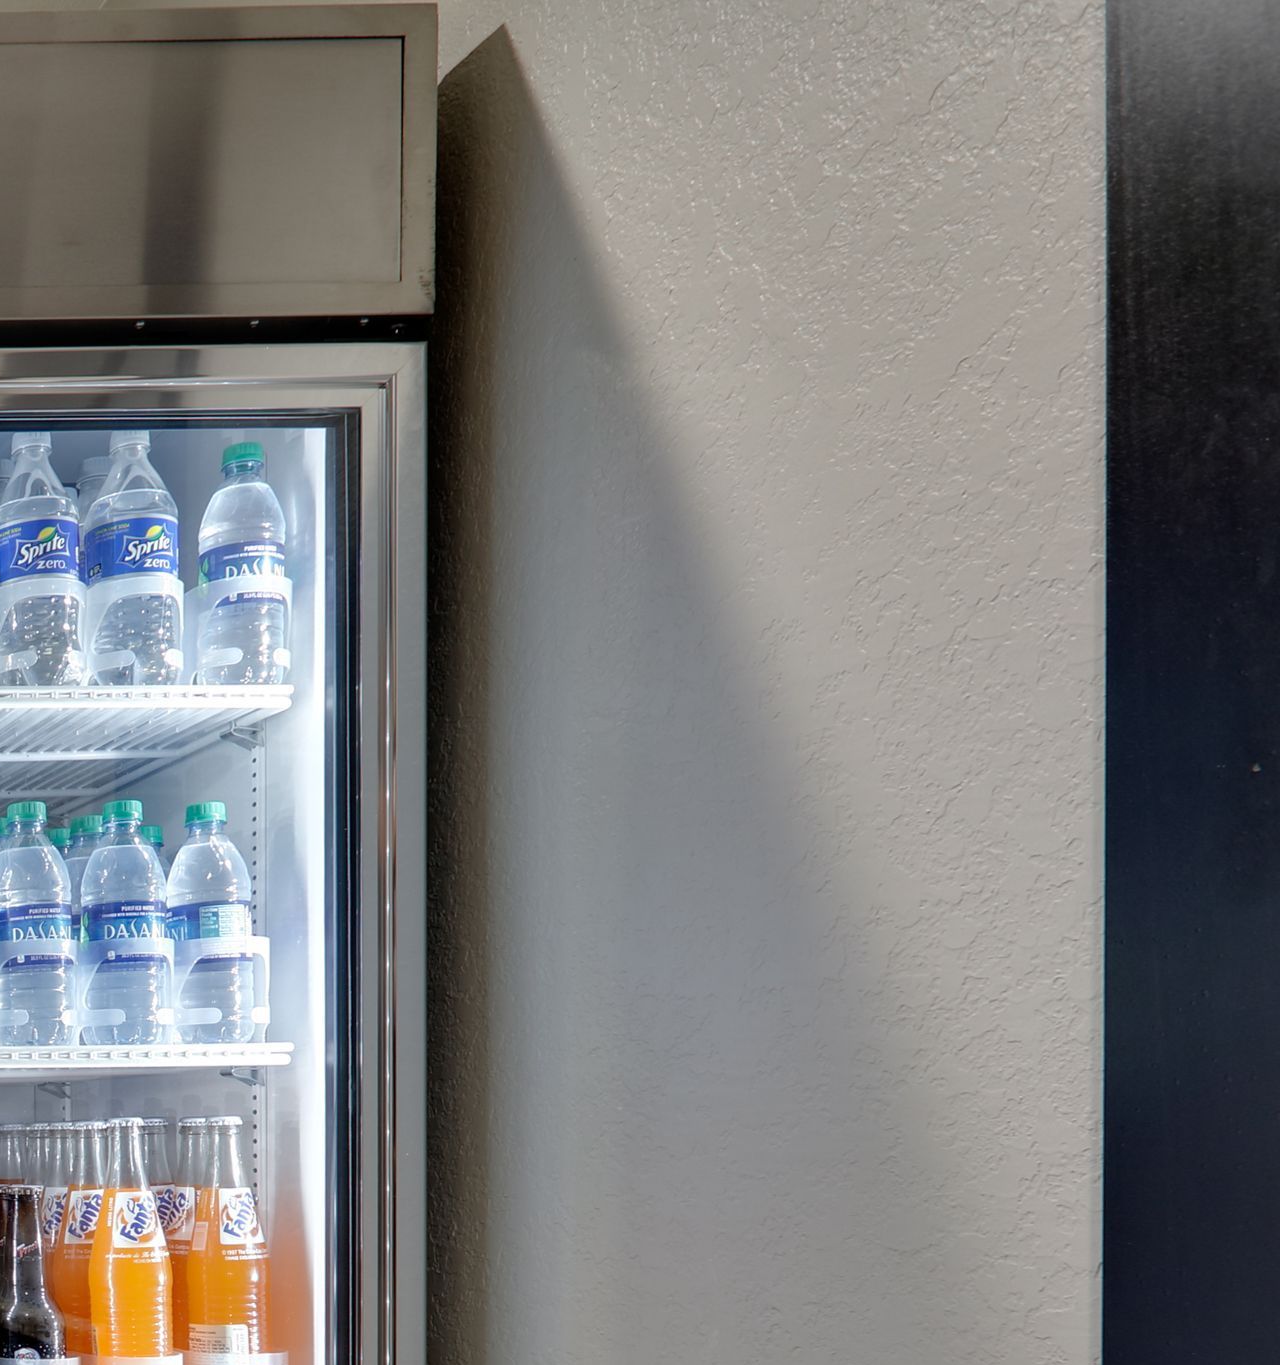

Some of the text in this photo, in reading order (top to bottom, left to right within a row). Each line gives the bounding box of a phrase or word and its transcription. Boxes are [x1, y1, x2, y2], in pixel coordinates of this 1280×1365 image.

[17, 533, 66, 565] Sprite
[124, 533, 171, 562] Sprite
[36, 559, 66, 569] zero
[144, 558, 171, 569] zero
[12, 921, 71, 943] DASANI
[104, 919, 167, 940] DASANI
[68, 1193, 103, 1239] Fanta
[119, 1195, 157, 1243] Fanta
[222, 1191, 258, 1239] Fanta
